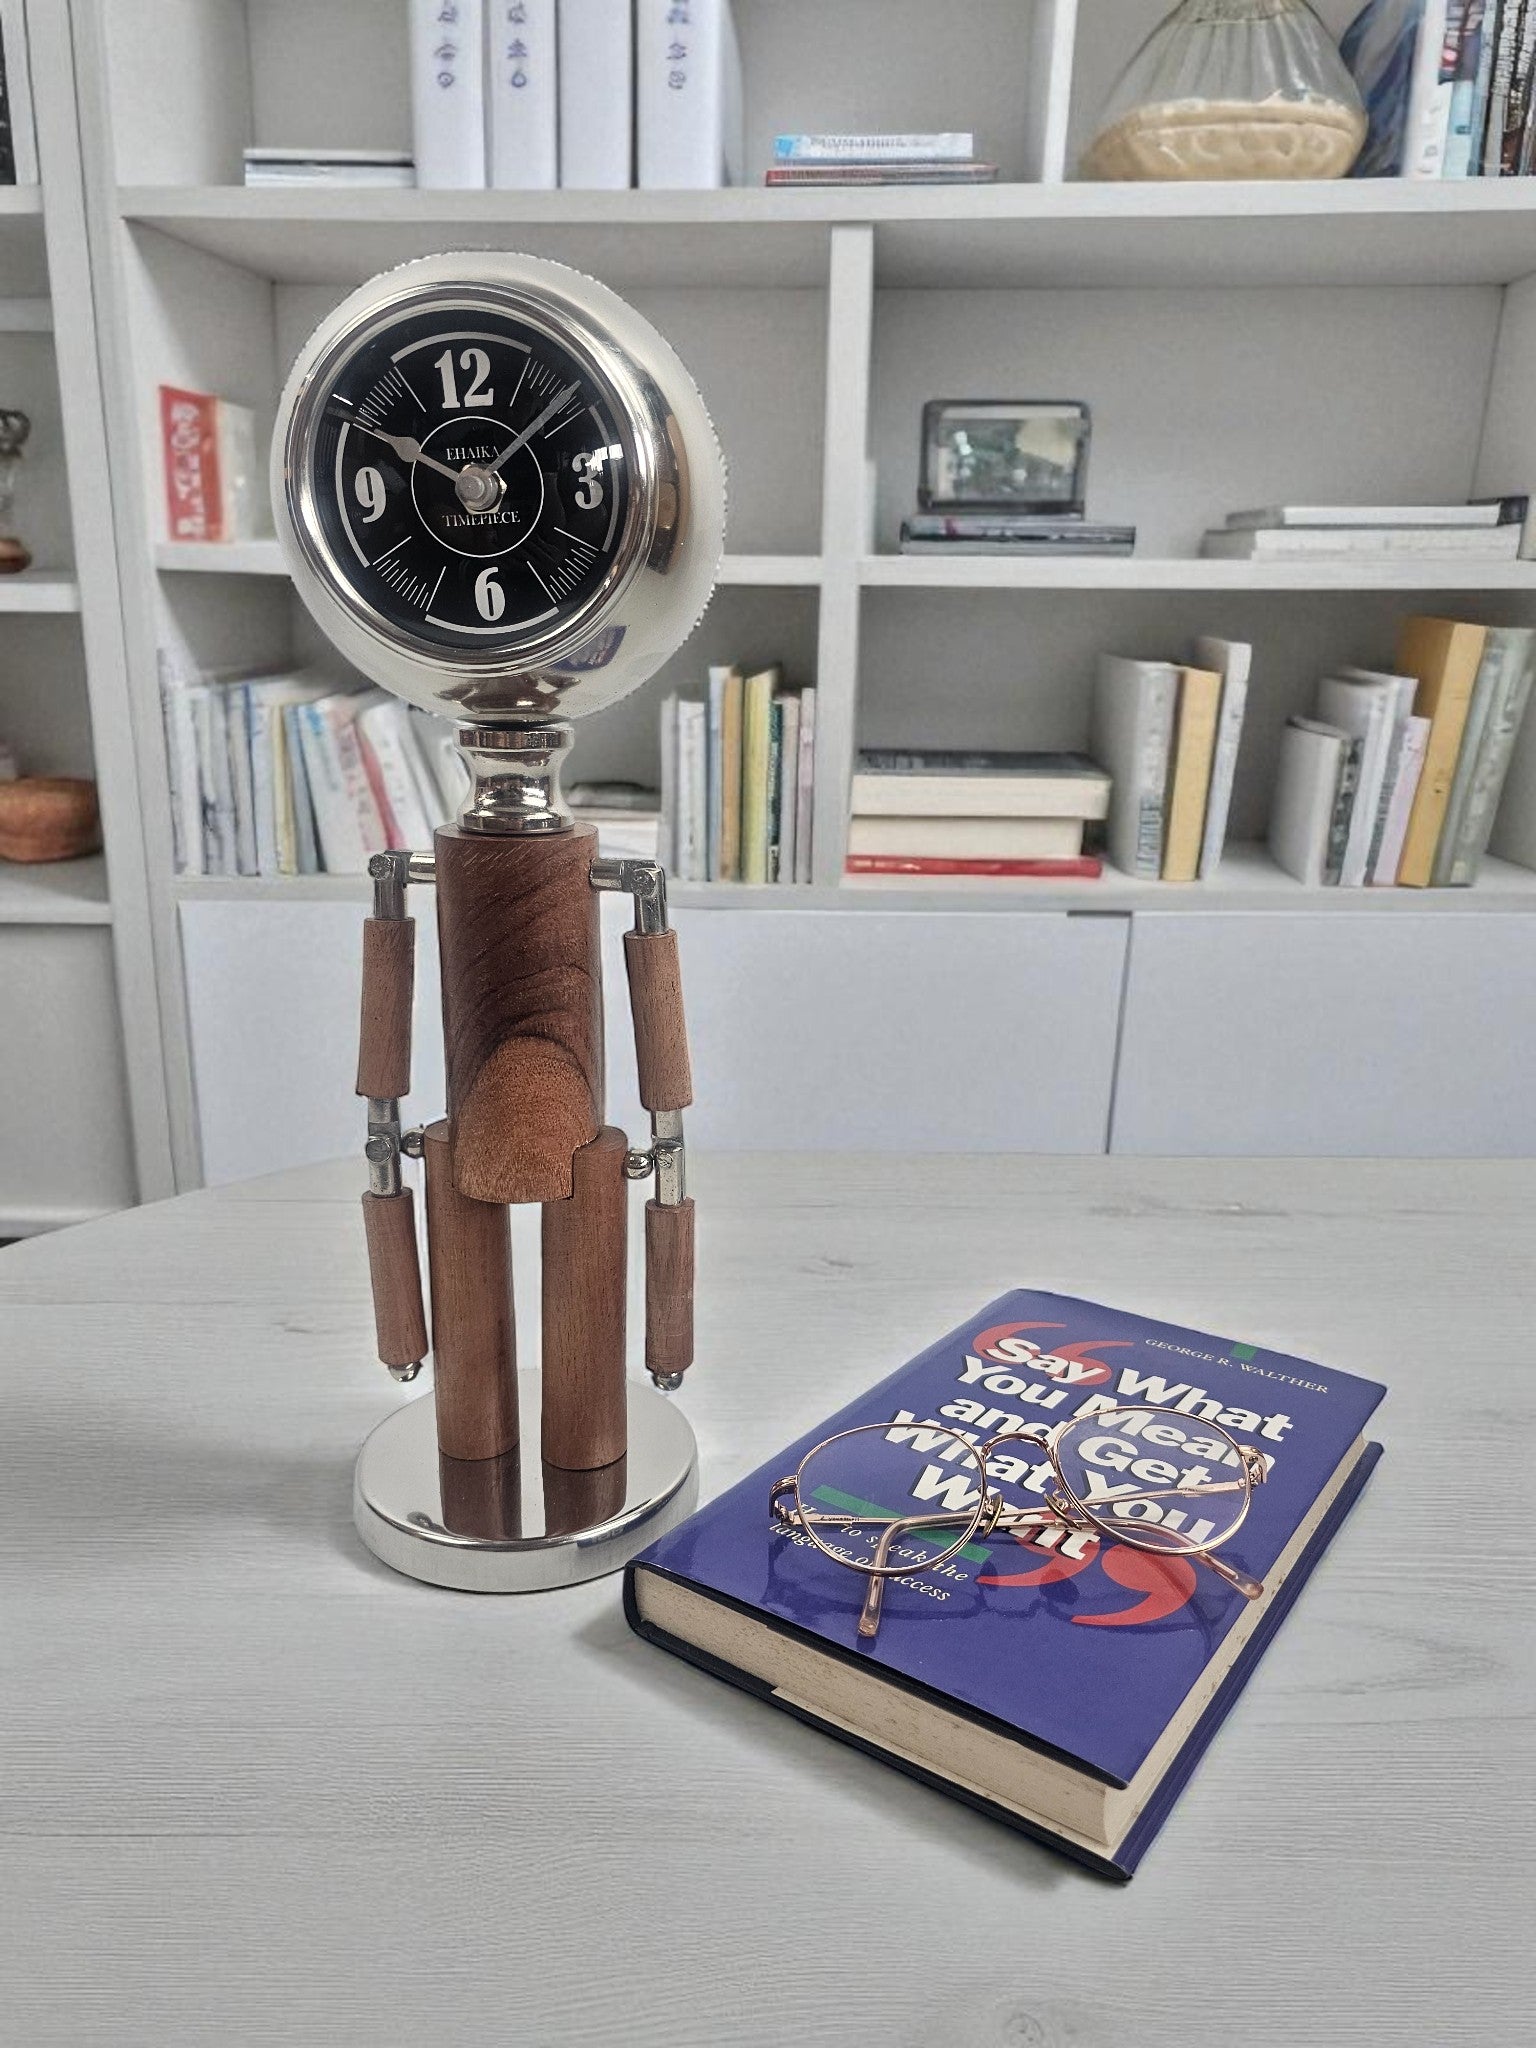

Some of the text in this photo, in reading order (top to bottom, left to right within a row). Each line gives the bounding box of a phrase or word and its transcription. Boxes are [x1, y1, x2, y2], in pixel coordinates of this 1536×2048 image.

[433, 348, 494, 410] 12
[446, 446, 501, 461] EHAIKA
[571, 452, 604, 511] 3
[354, 466, 387, 524] 9
[441, 510, 521, 527] TIMEPIECE
[474, 566, 506, 622] 6
[985, 1337, 1295, 1443] Say What
[1145, 1338, 1328, 1394] GEORGE R. WALTHER
[939, 1398, 1213, 1492] and Get
[955, 1354, 1276, 1478] You Mean
[884, 1410, 1216, 1544] What You
[911, 1464, 1101, 1560] Wnt
[866, 1535, 928, 1563] seak
[931, 1562, 969, 1581] the
[888, 1571, 951, 1601] ccess
